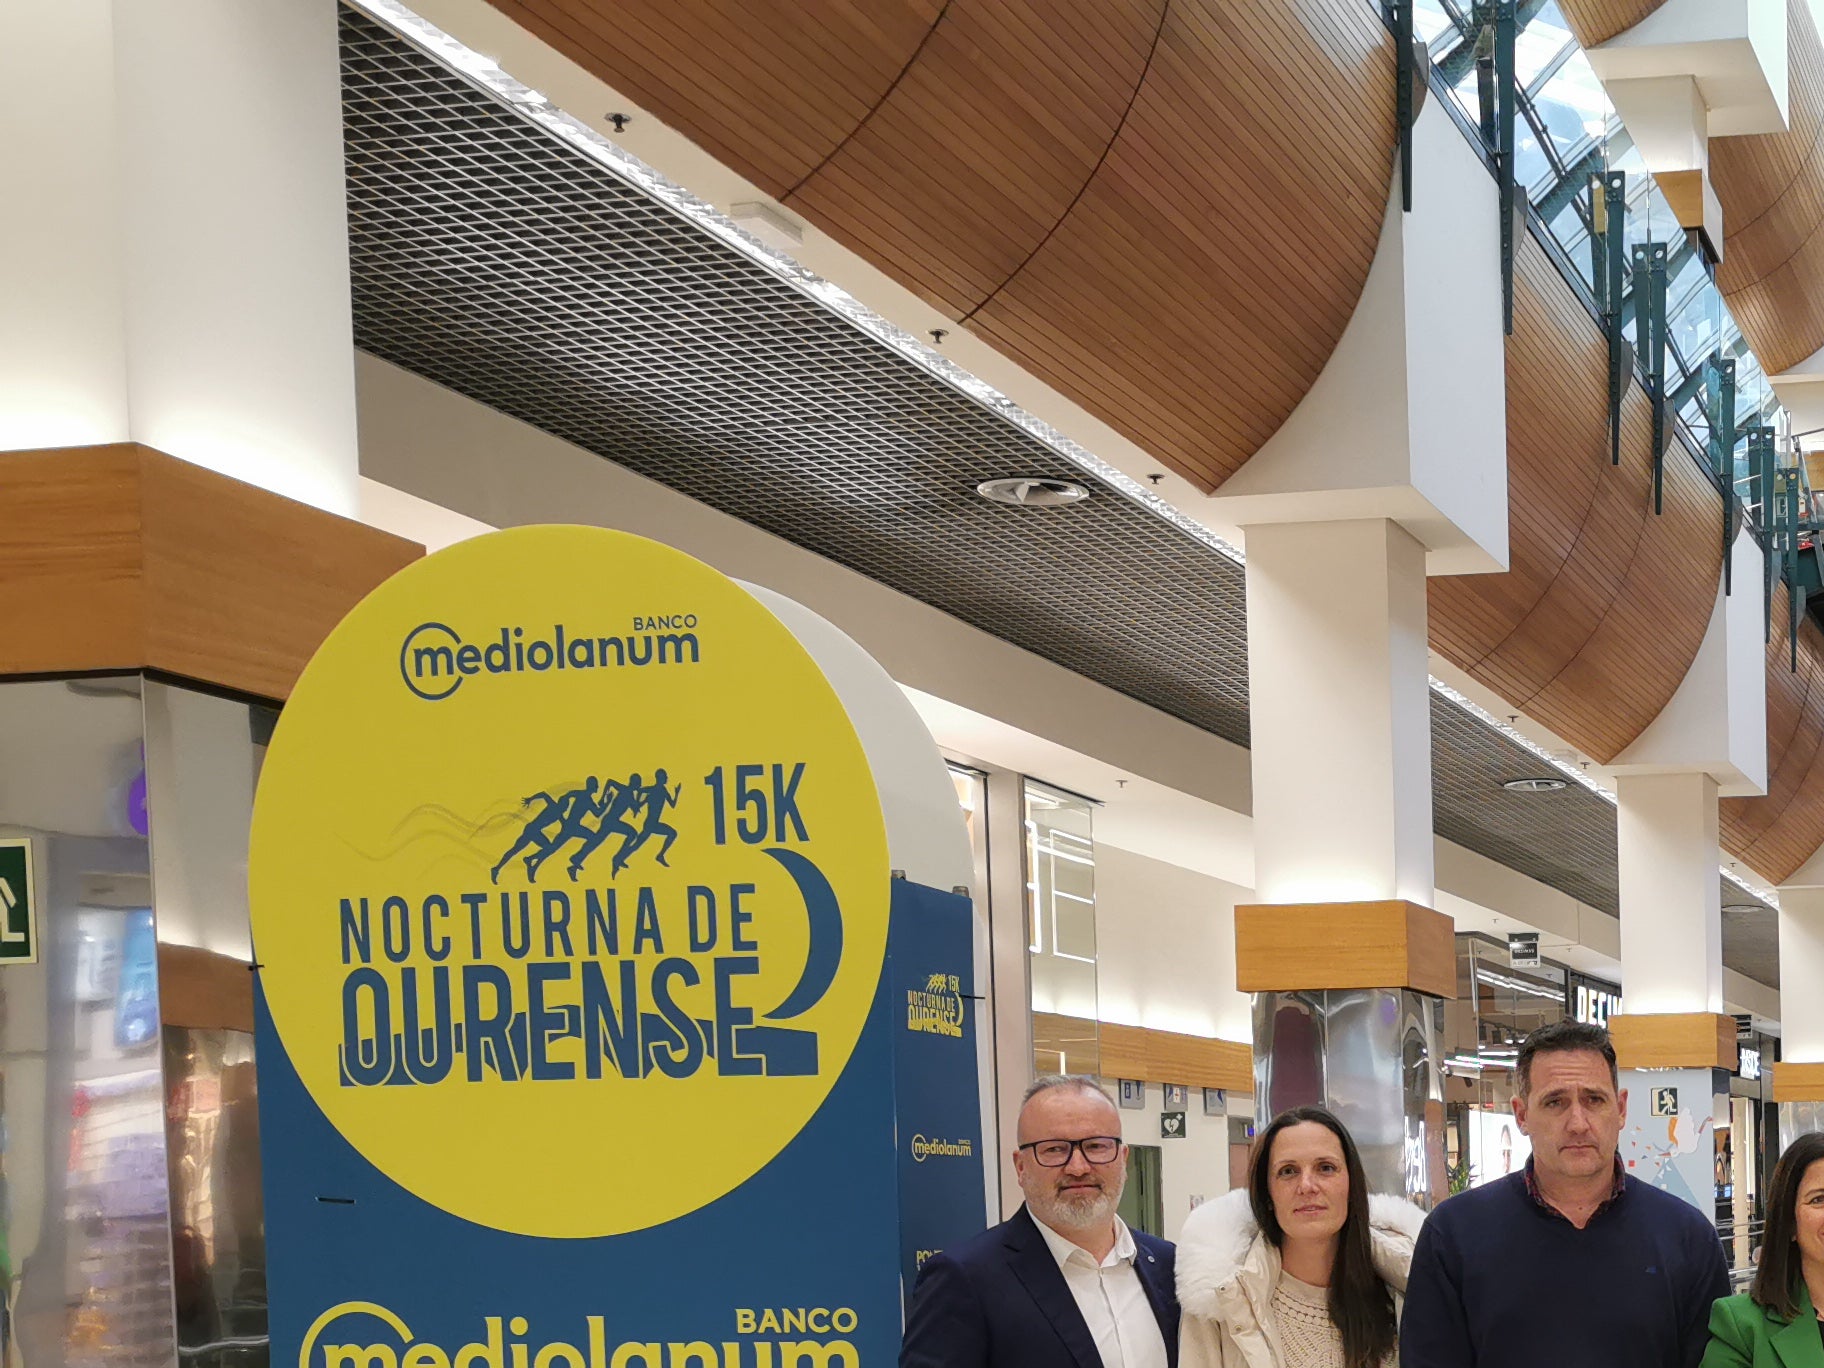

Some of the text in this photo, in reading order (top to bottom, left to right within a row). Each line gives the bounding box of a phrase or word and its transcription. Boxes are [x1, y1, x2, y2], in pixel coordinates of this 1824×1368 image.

[634, 614, 698, 632] BANCO
[413, 624, 699, 676] mediolanum
[705, 764, 809, 845] 15K
[341, 883, 759, 964] NOCTURNA DE
[948, 974, 960, 993] 15K
[907, 990, 956, 1012] NOCTURNA DE
[341, 957, 767, 1085] OURENSE
[914, 1138, 972, 1157] mediolanum
[737, 1308, 857, 1333] BANCO
